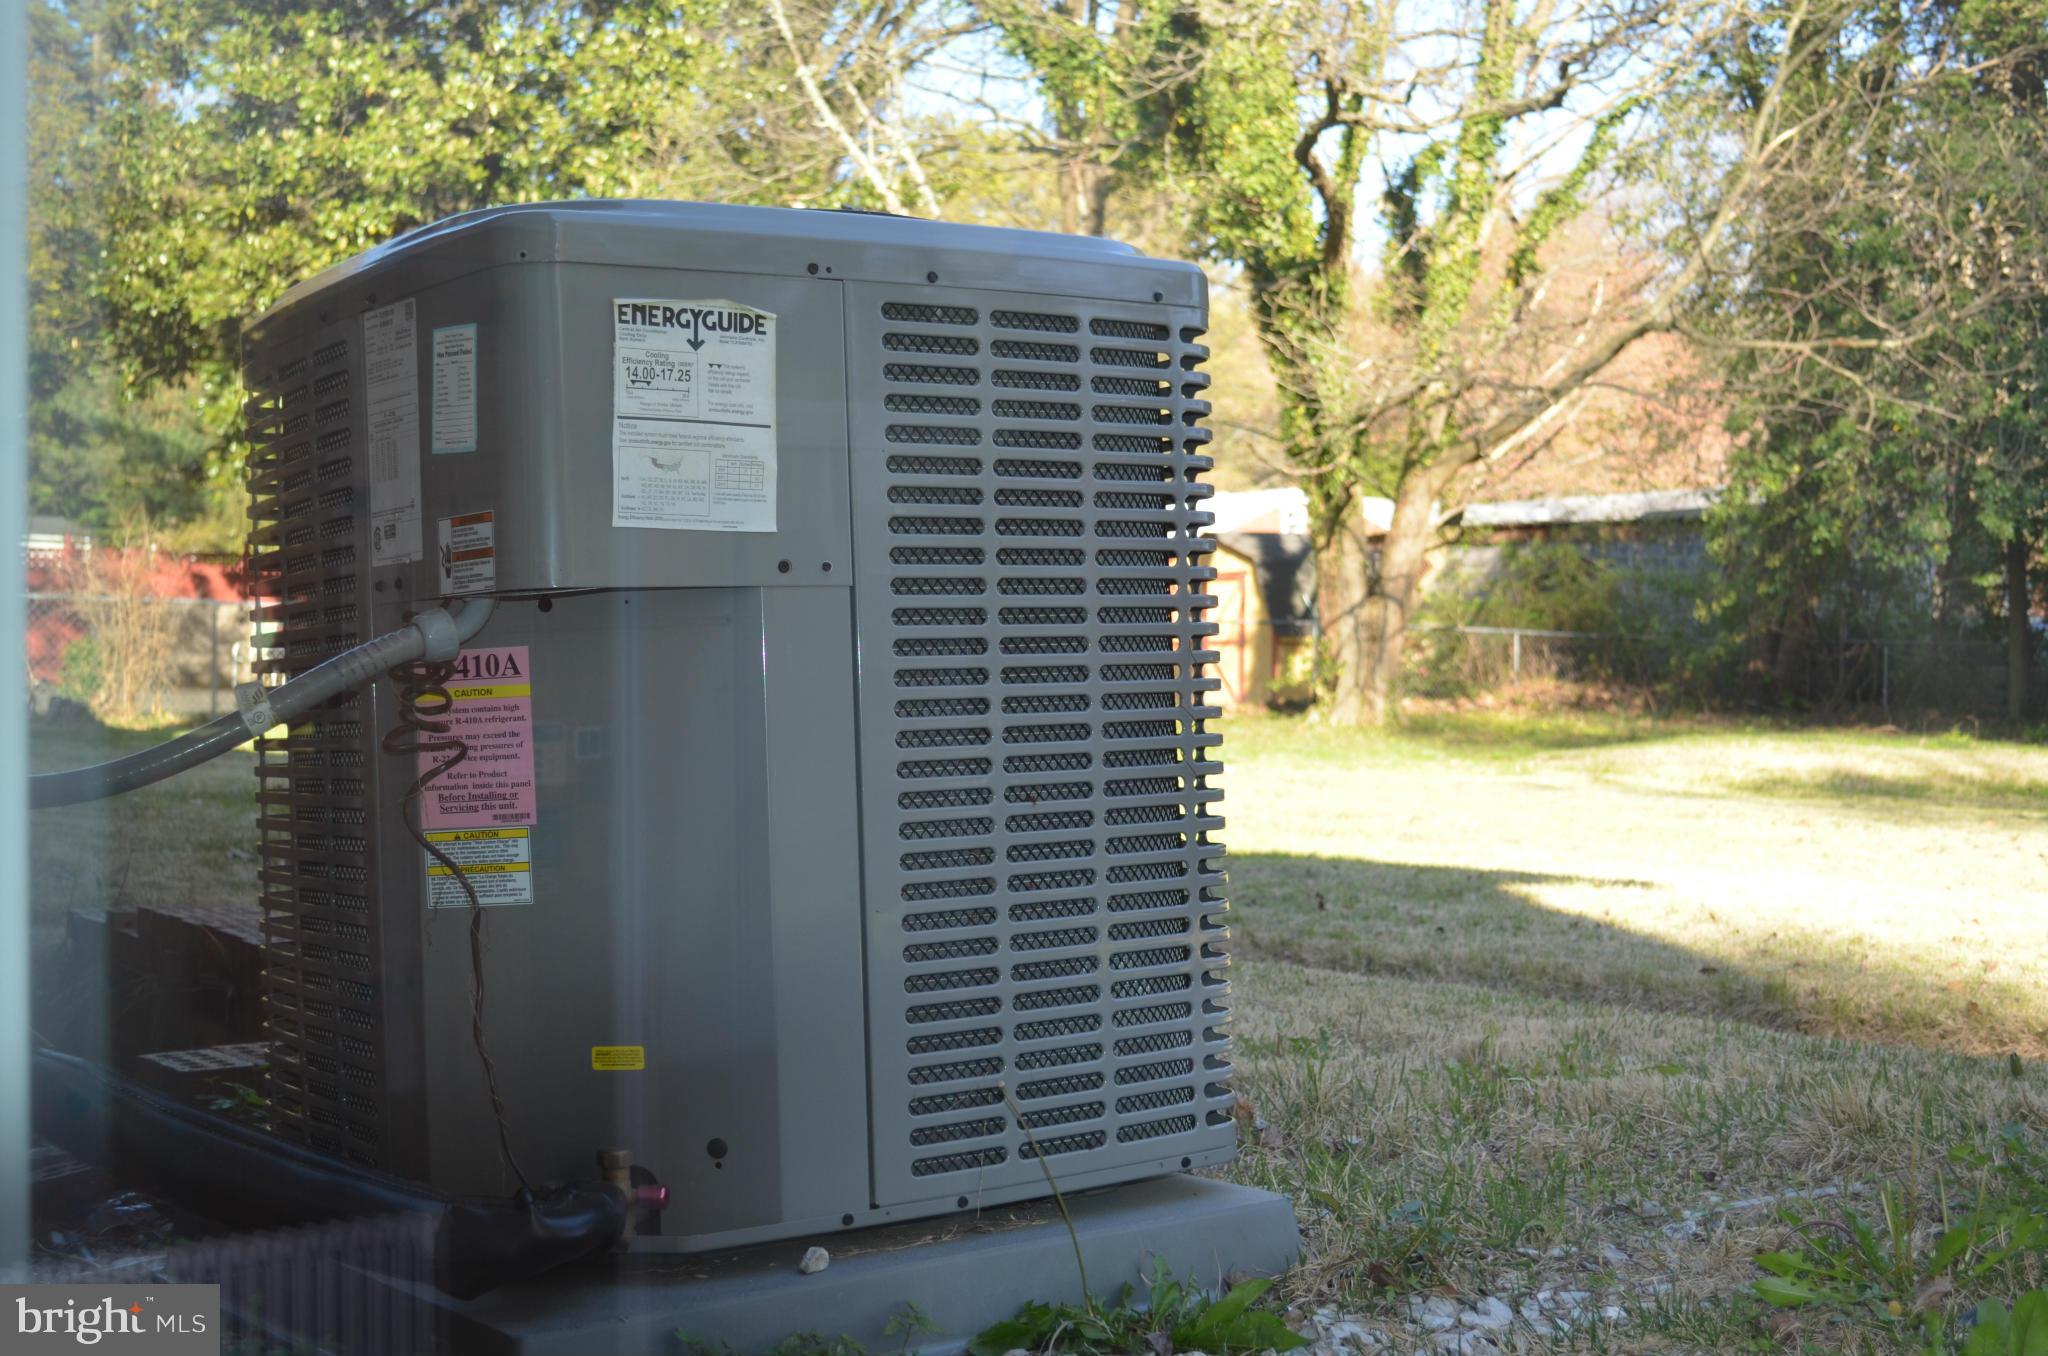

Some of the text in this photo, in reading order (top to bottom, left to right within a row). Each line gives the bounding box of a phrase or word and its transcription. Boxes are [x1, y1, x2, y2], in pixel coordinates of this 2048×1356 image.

[617, 303, 767, 336] ENERGYGUIDE
[645, 351, 670, 361] Cooling
[622, 356, 653, 367] Efficiency
[655, 358, 676, 369] Rating
[625, 366, 692, 383] 14.00-17.25
[454, 687, 493, 698] CAUTION
[471, 704, 502, 713] contains
[503, 703, 520, 714] high
[455, 716, 484, 725] R-410A
[484, 714, 527, 725] refrigerant.
[428, 733, 463, 742] Pressures
[465, 732, 480, 741] may
[508, 730, 520, 738] the
[480, 743, 514, 752] pressures
[515, 741, 523, 749] of
[479, 752, 520, 763] equipment.
[447, 770, 507, 780] Refer to Product
[424, 779, 531, 792] information inside this panel
[438, 791, 519, 802] Before Installing or
[440, 801, 518, 813] Servicing this unit.
[463, 830, 499, 840] CAUTION
